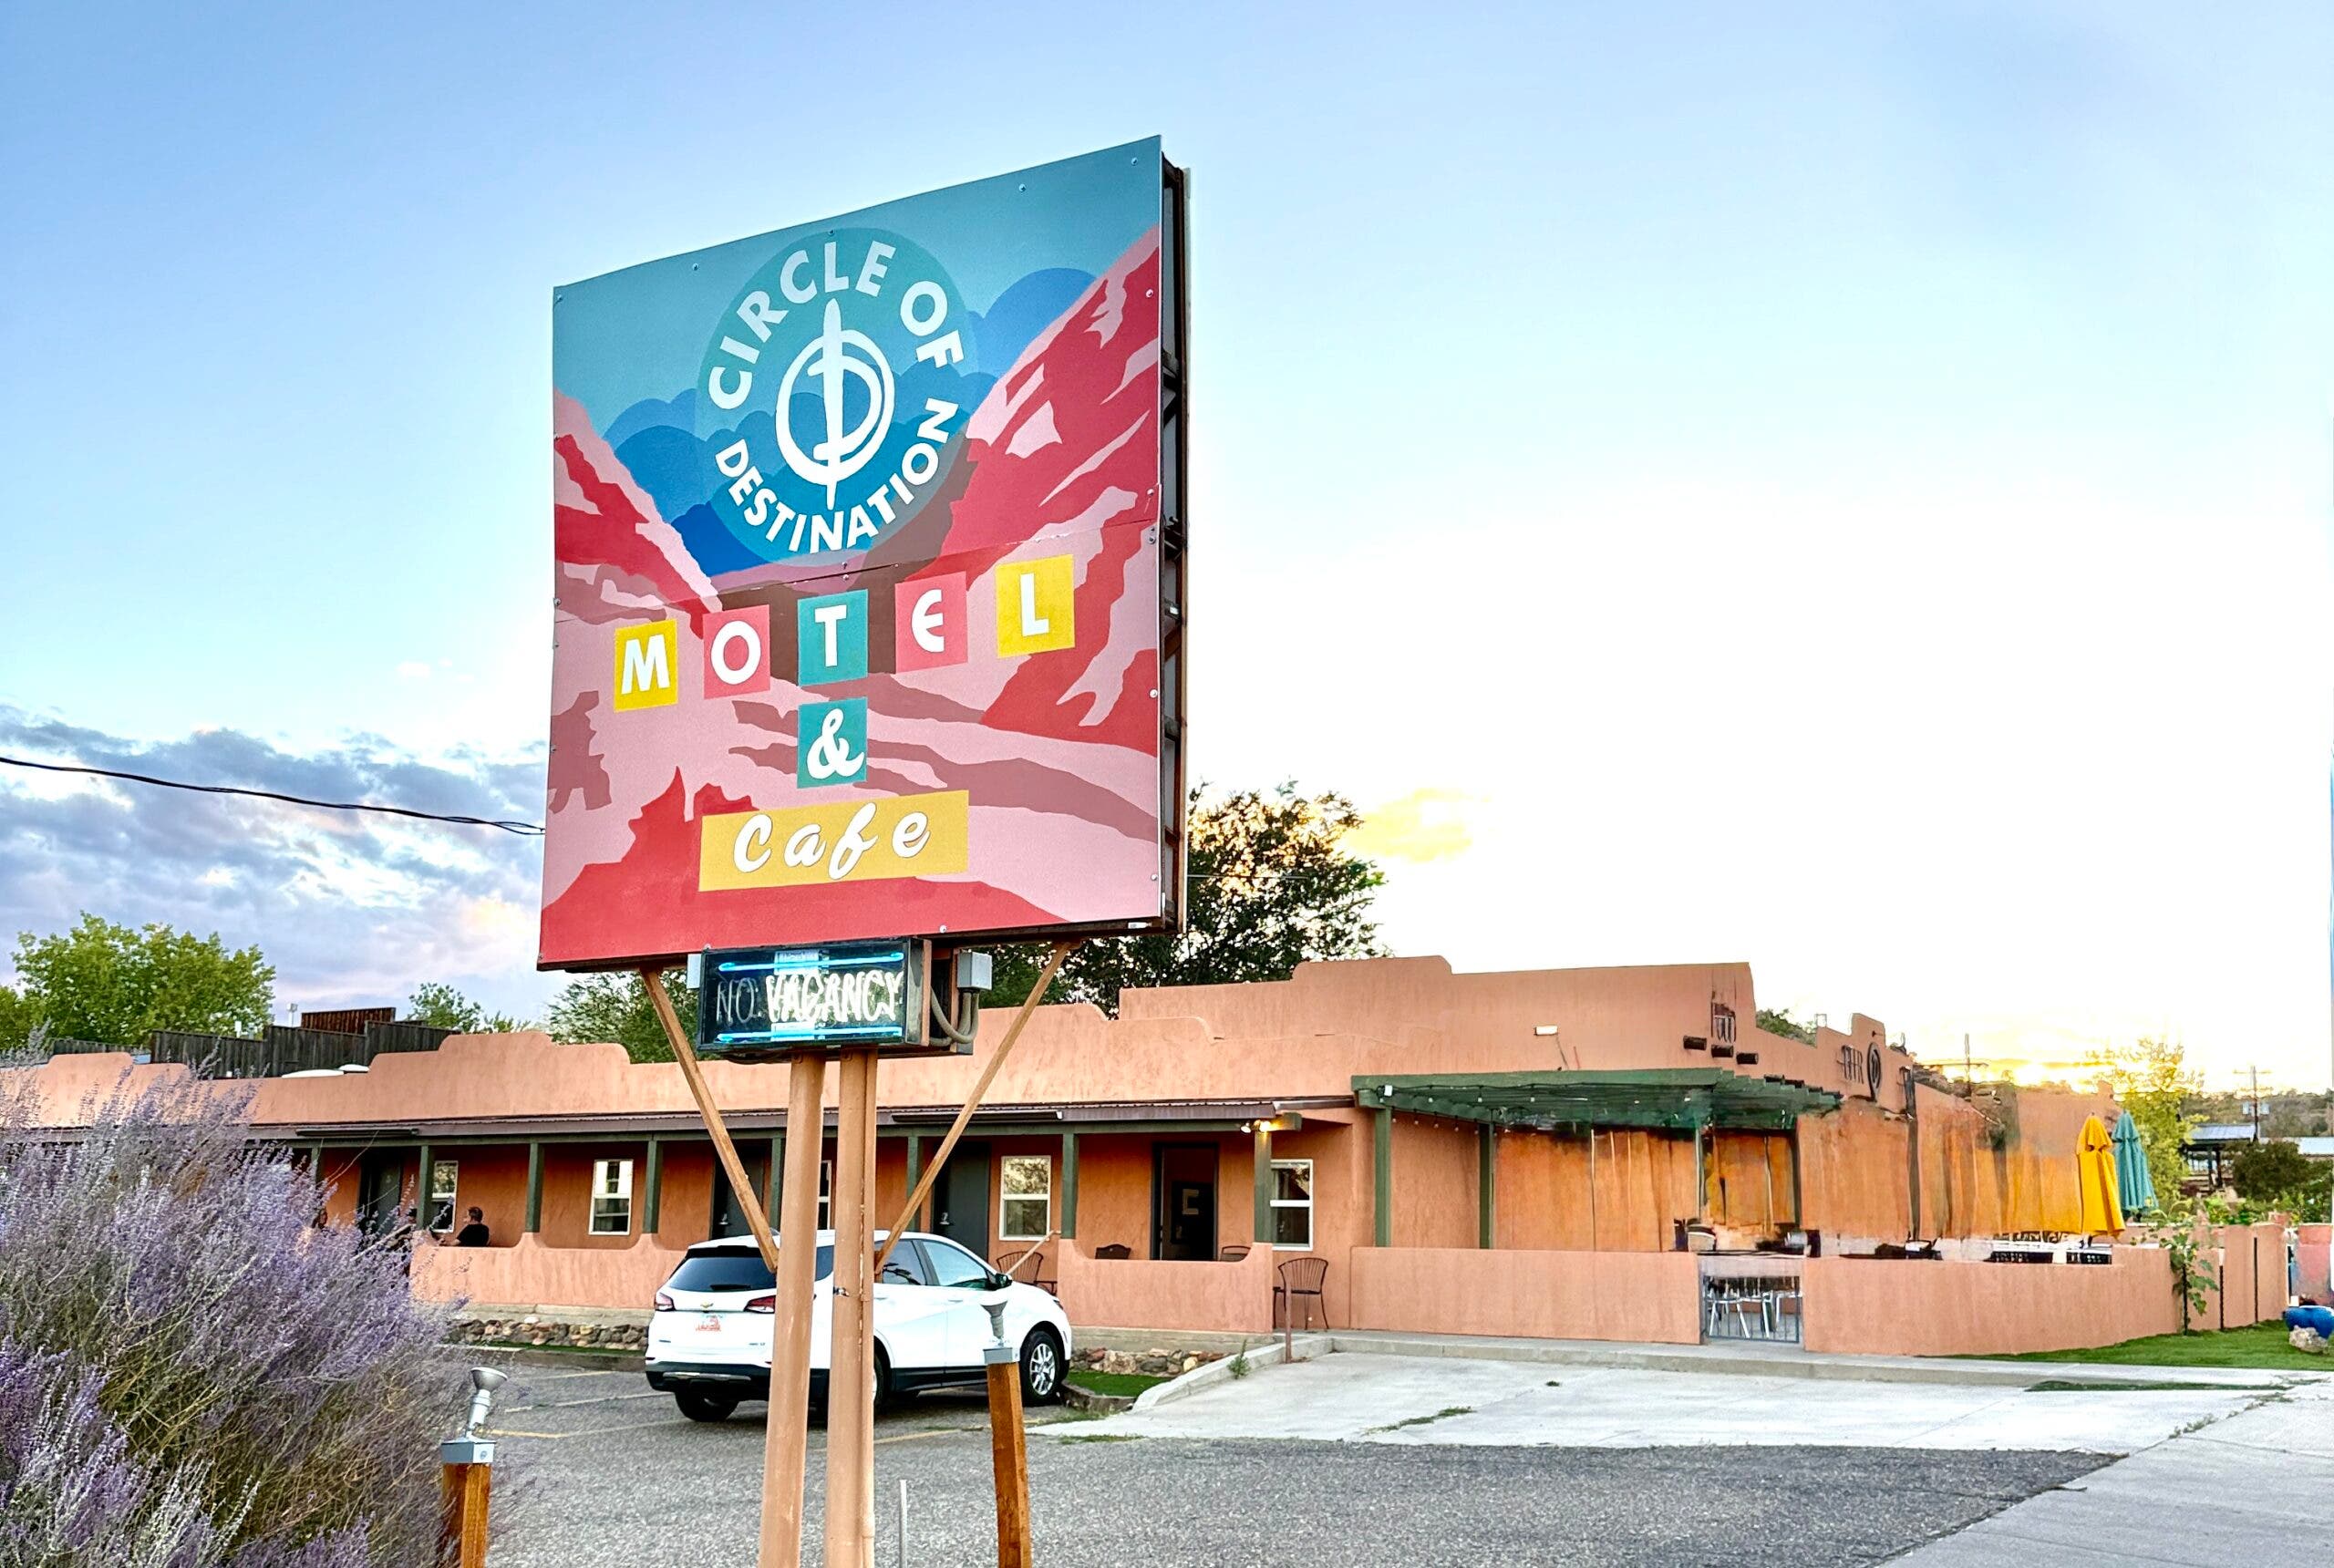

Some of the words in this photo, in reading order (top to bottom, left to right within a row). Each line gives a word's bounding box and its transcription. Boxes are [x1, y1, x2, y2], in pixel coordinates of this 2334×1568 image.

[708, 241, 896, 409] CIRCLE
[900, 281, 964, 367] OF
[715, 397, 958, 553] DESTINATION
[621, 573, 1048, 695] MOTEL
[806, 708, 865, 779] &
[733, 802, 930, 880] Cafe
[716, 977, 756, 1025] NO
[766, 969, 904, 1023] VACANCY
